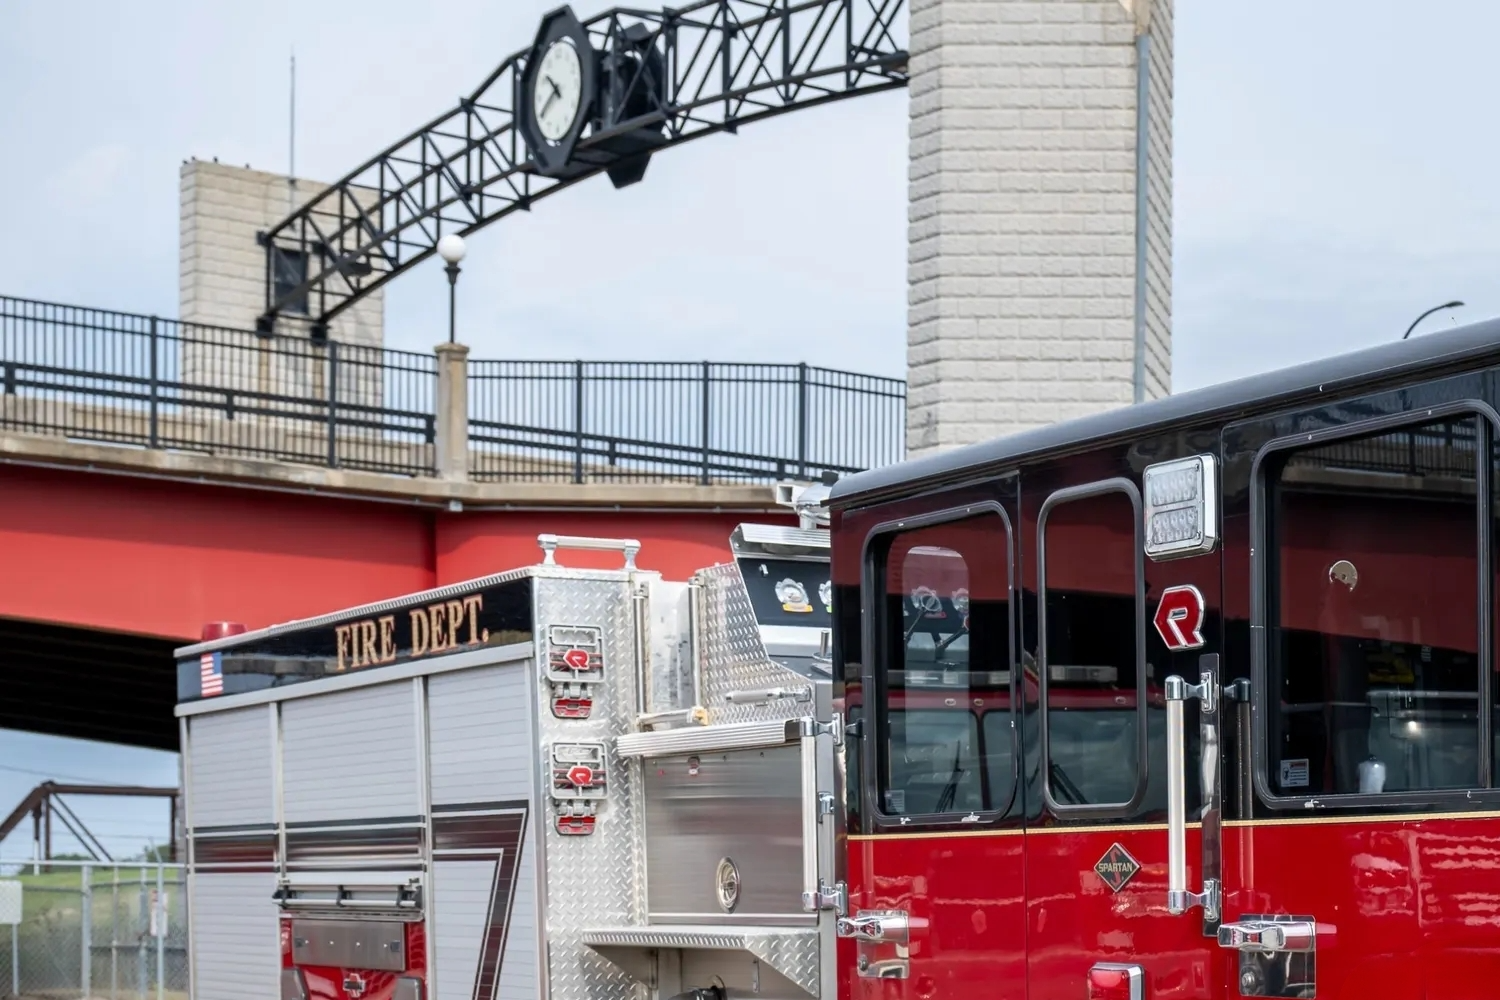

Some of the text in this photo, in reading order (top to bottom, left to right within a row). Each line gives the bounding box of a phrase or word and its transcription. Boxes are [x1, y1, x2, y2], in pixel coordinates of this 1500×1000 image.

[335, 594, 489, 671] FIRE DEPT.
[1098, 862, 1133, 873] SPARTAN
